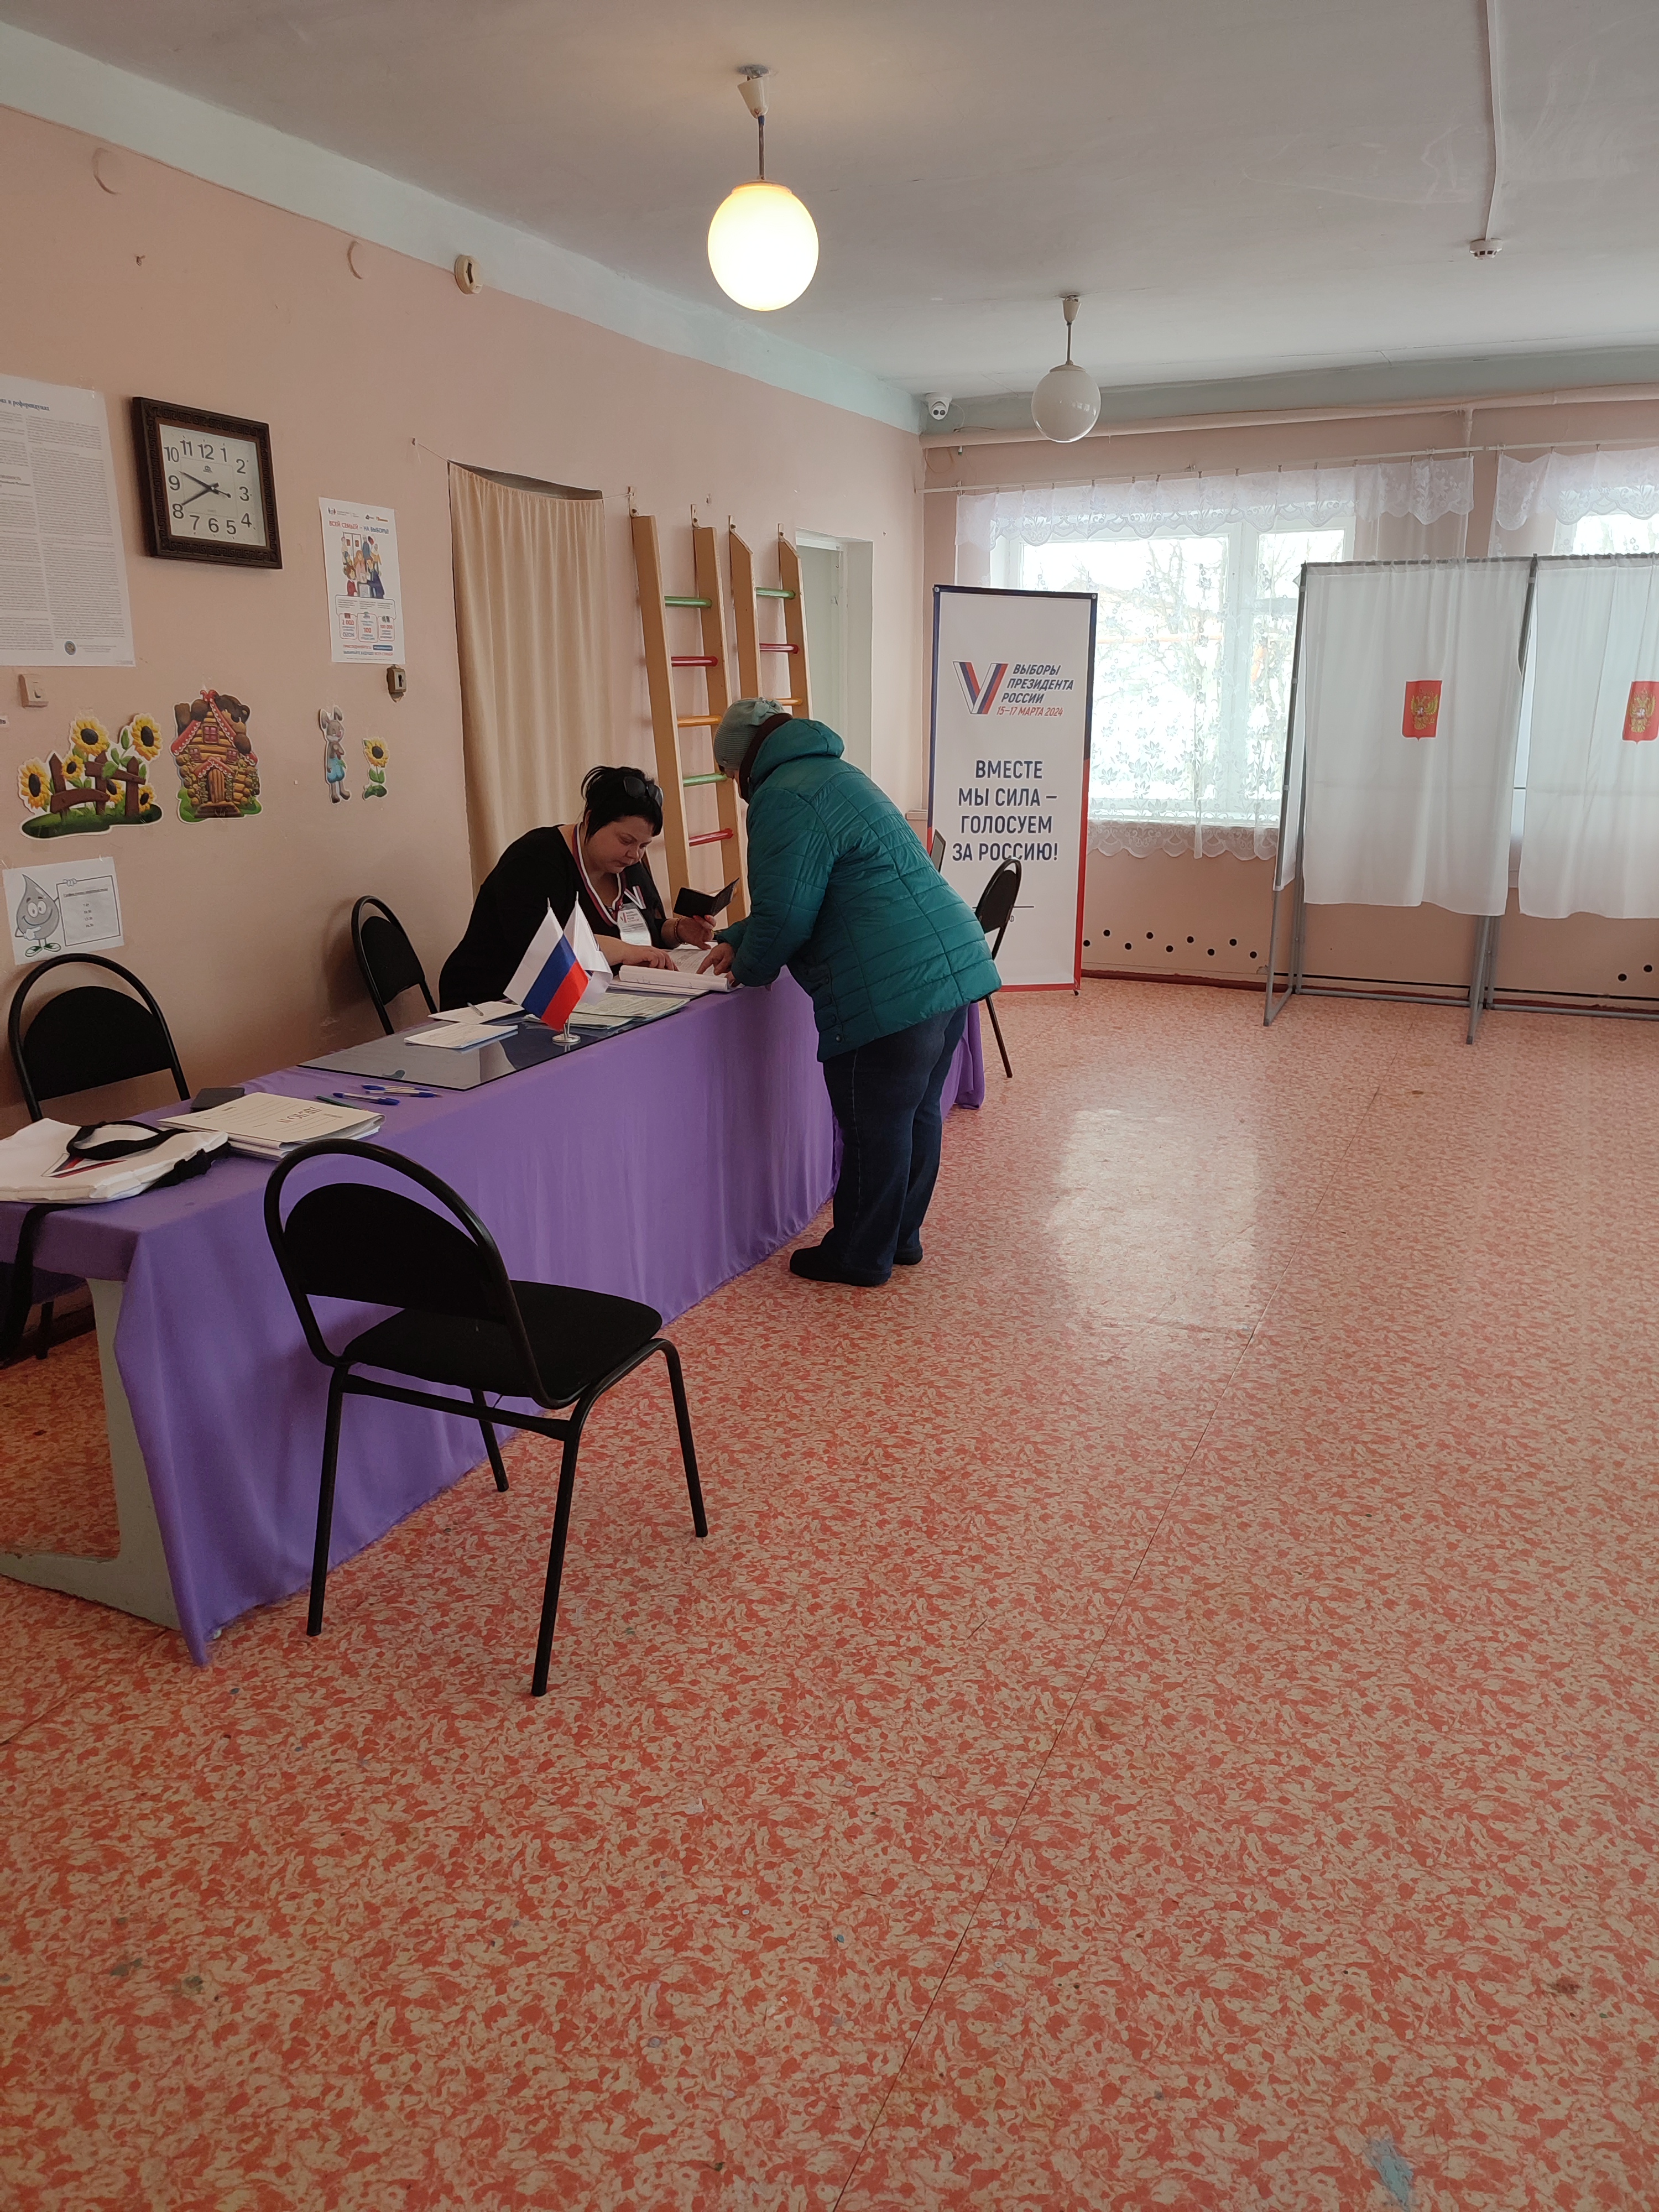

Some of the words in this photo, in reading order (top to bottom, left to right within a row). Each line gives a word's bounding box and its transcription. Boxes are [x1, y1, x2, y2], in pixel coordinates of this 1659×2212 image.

[164, 446, 179, 462] 10
[180, 440, 192, 456] 11
[197, 444, 214, 460] 12
[221, 447, 227, 462] 1
[236, 459, 246, 474] 2
[168, 475, 180, 491] 9
[239, 487, 249, 502] 3
[172, 504, 184, 519] 8
[190, 515, 200, 530] 7
[208, 518, 219, 533] 6
[226, 520, 236, 535] 5
[241, 513, 252, 528] 4
[1013, 664, 1061, 675] ВЫБОРЫ
[1006, 679, 1074, 691] ПРЕЗИДЕНТА
[1001, 693, 1045, 703] РОССИИ
[1018, 707, 1044, 716] МАРТА
[1044, 707, 1063, 716] 2024
[975, 760, 1043, 779] ВМЕСТЕ
[958, 788, 989, 806] МЫ
[995, 788, 1041, 806] СИЛА
[961, 816, 1052, 833] ГОЛОСУЕМ
[952, 843, 973, 861] ЗА
[979, 843, 1058, 861] РОССИЮ!
